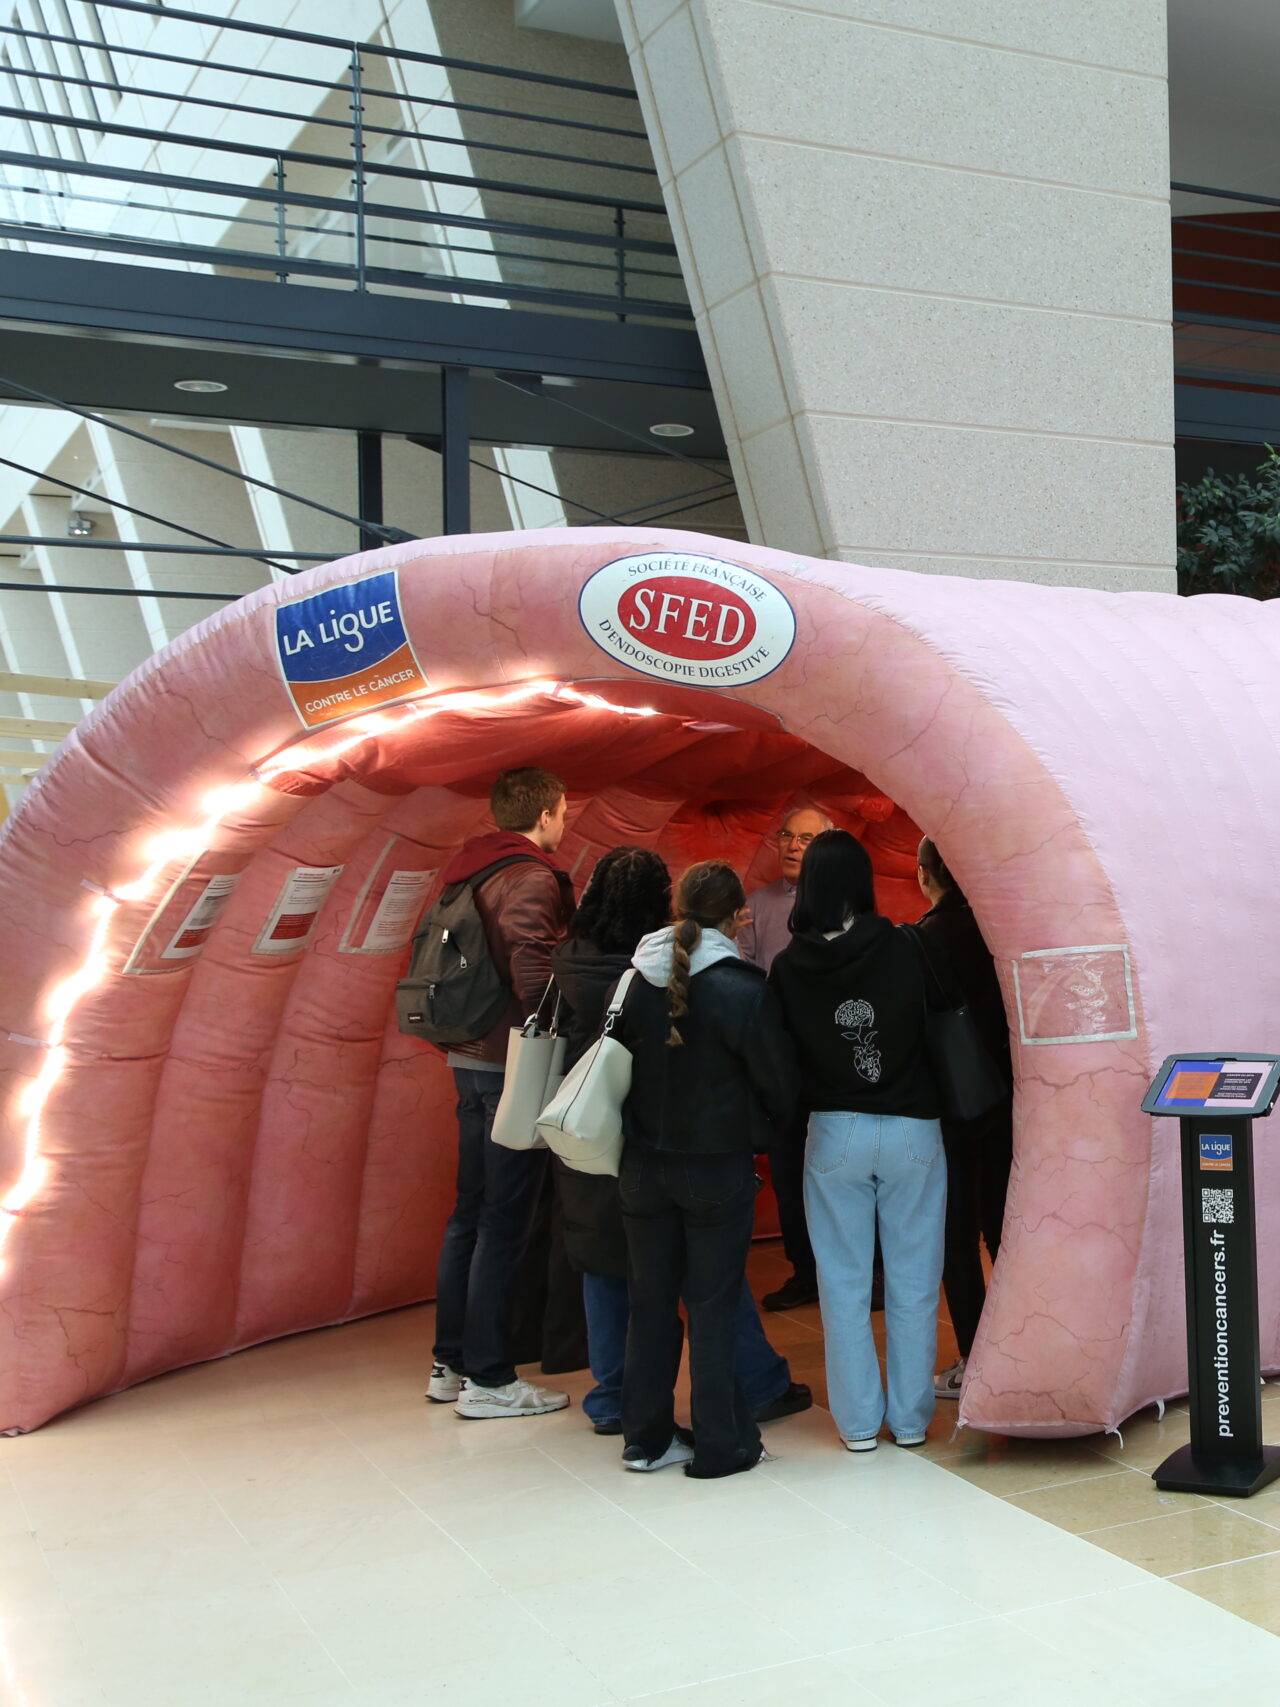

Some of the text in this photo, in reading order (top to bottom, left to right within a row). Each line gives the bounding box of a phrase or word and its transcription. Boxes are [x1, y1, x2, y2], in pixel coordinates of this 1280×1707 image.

[628, 558, 766, 602] SOCIÉTÉ FRANÇAISE
[629, 588, 745, 646] SFED
[283, 630, 315, 656] LA
[599, 619, 770, 678] D'ENDOSCOPIE DIGESTIVE
[305, 669, 415, 712] CONTRE LE CANCER
[1210, 1230, 1234, 1437] preventioncancers.fr
